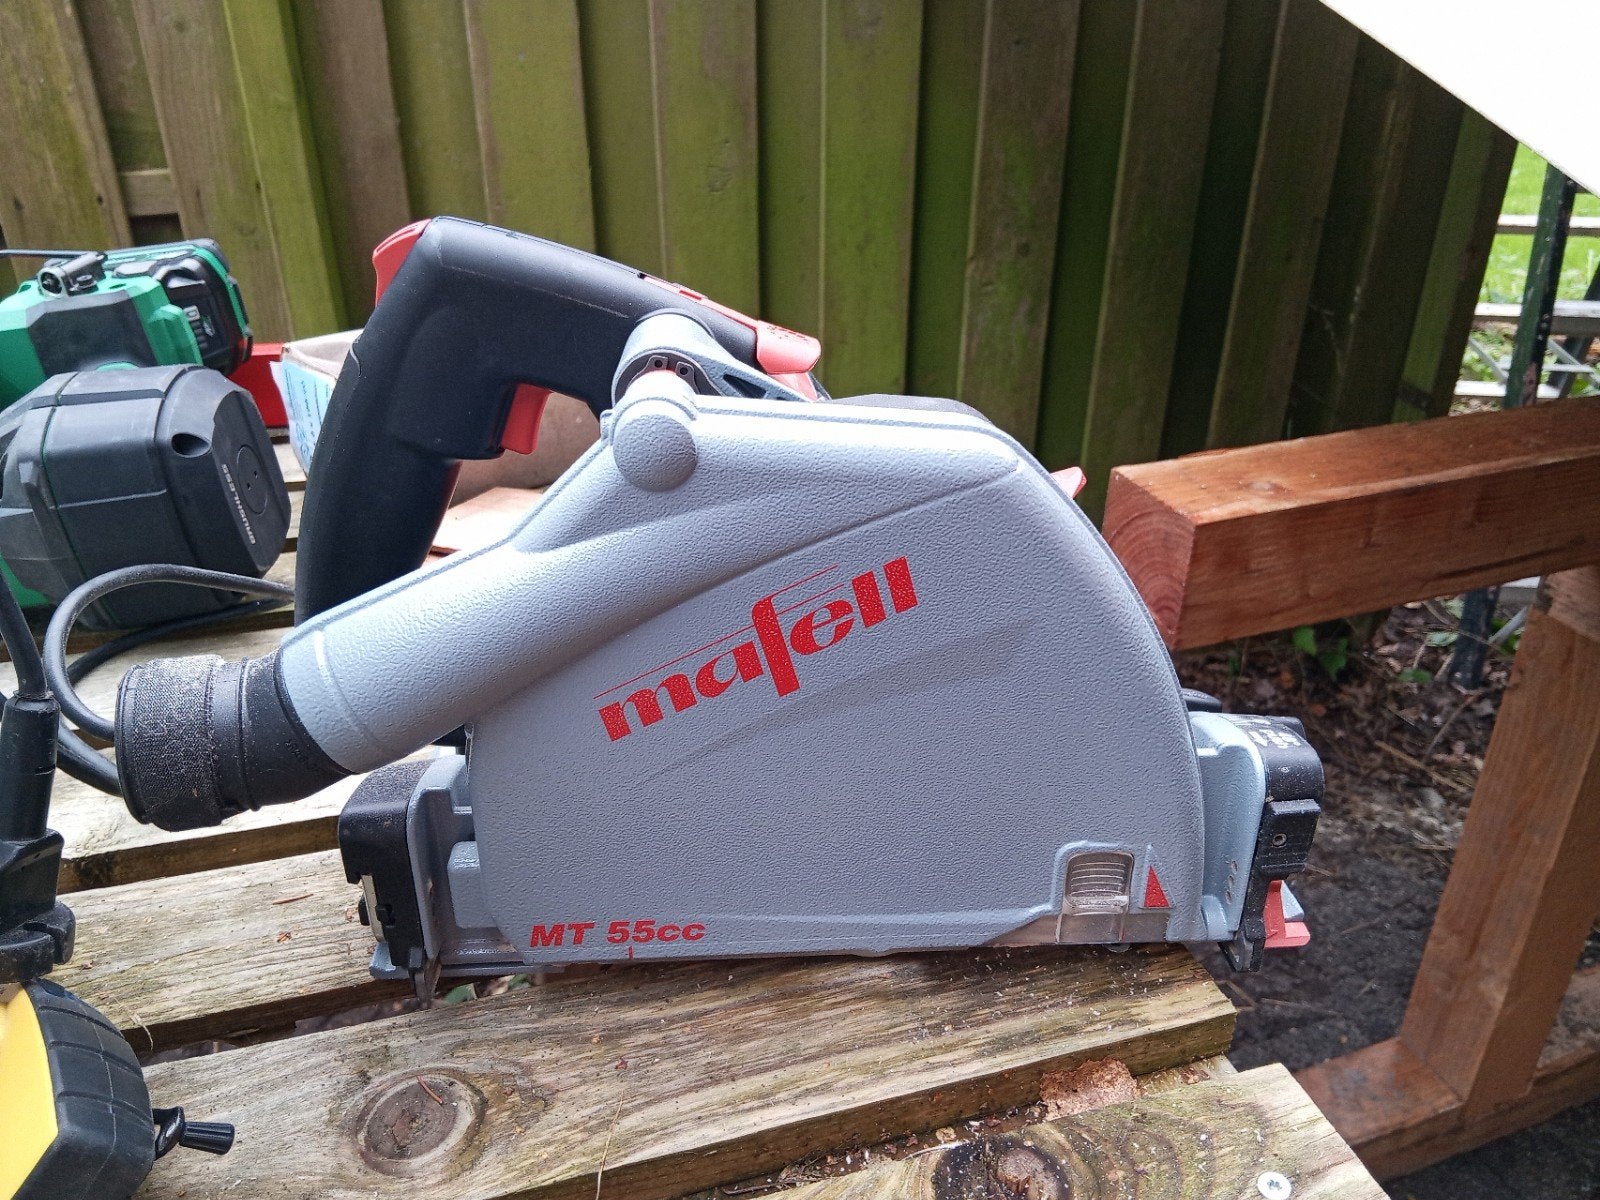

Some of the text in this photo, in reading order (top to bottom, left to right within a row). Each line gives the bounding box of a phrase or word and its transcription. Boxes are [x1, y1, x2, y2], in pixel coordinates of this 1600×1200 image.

[221, 463, 256, 545] BRUSHLESS
[598, 556, 918, 742] mafell
[530, 919, 705, 948] MT 55cc
